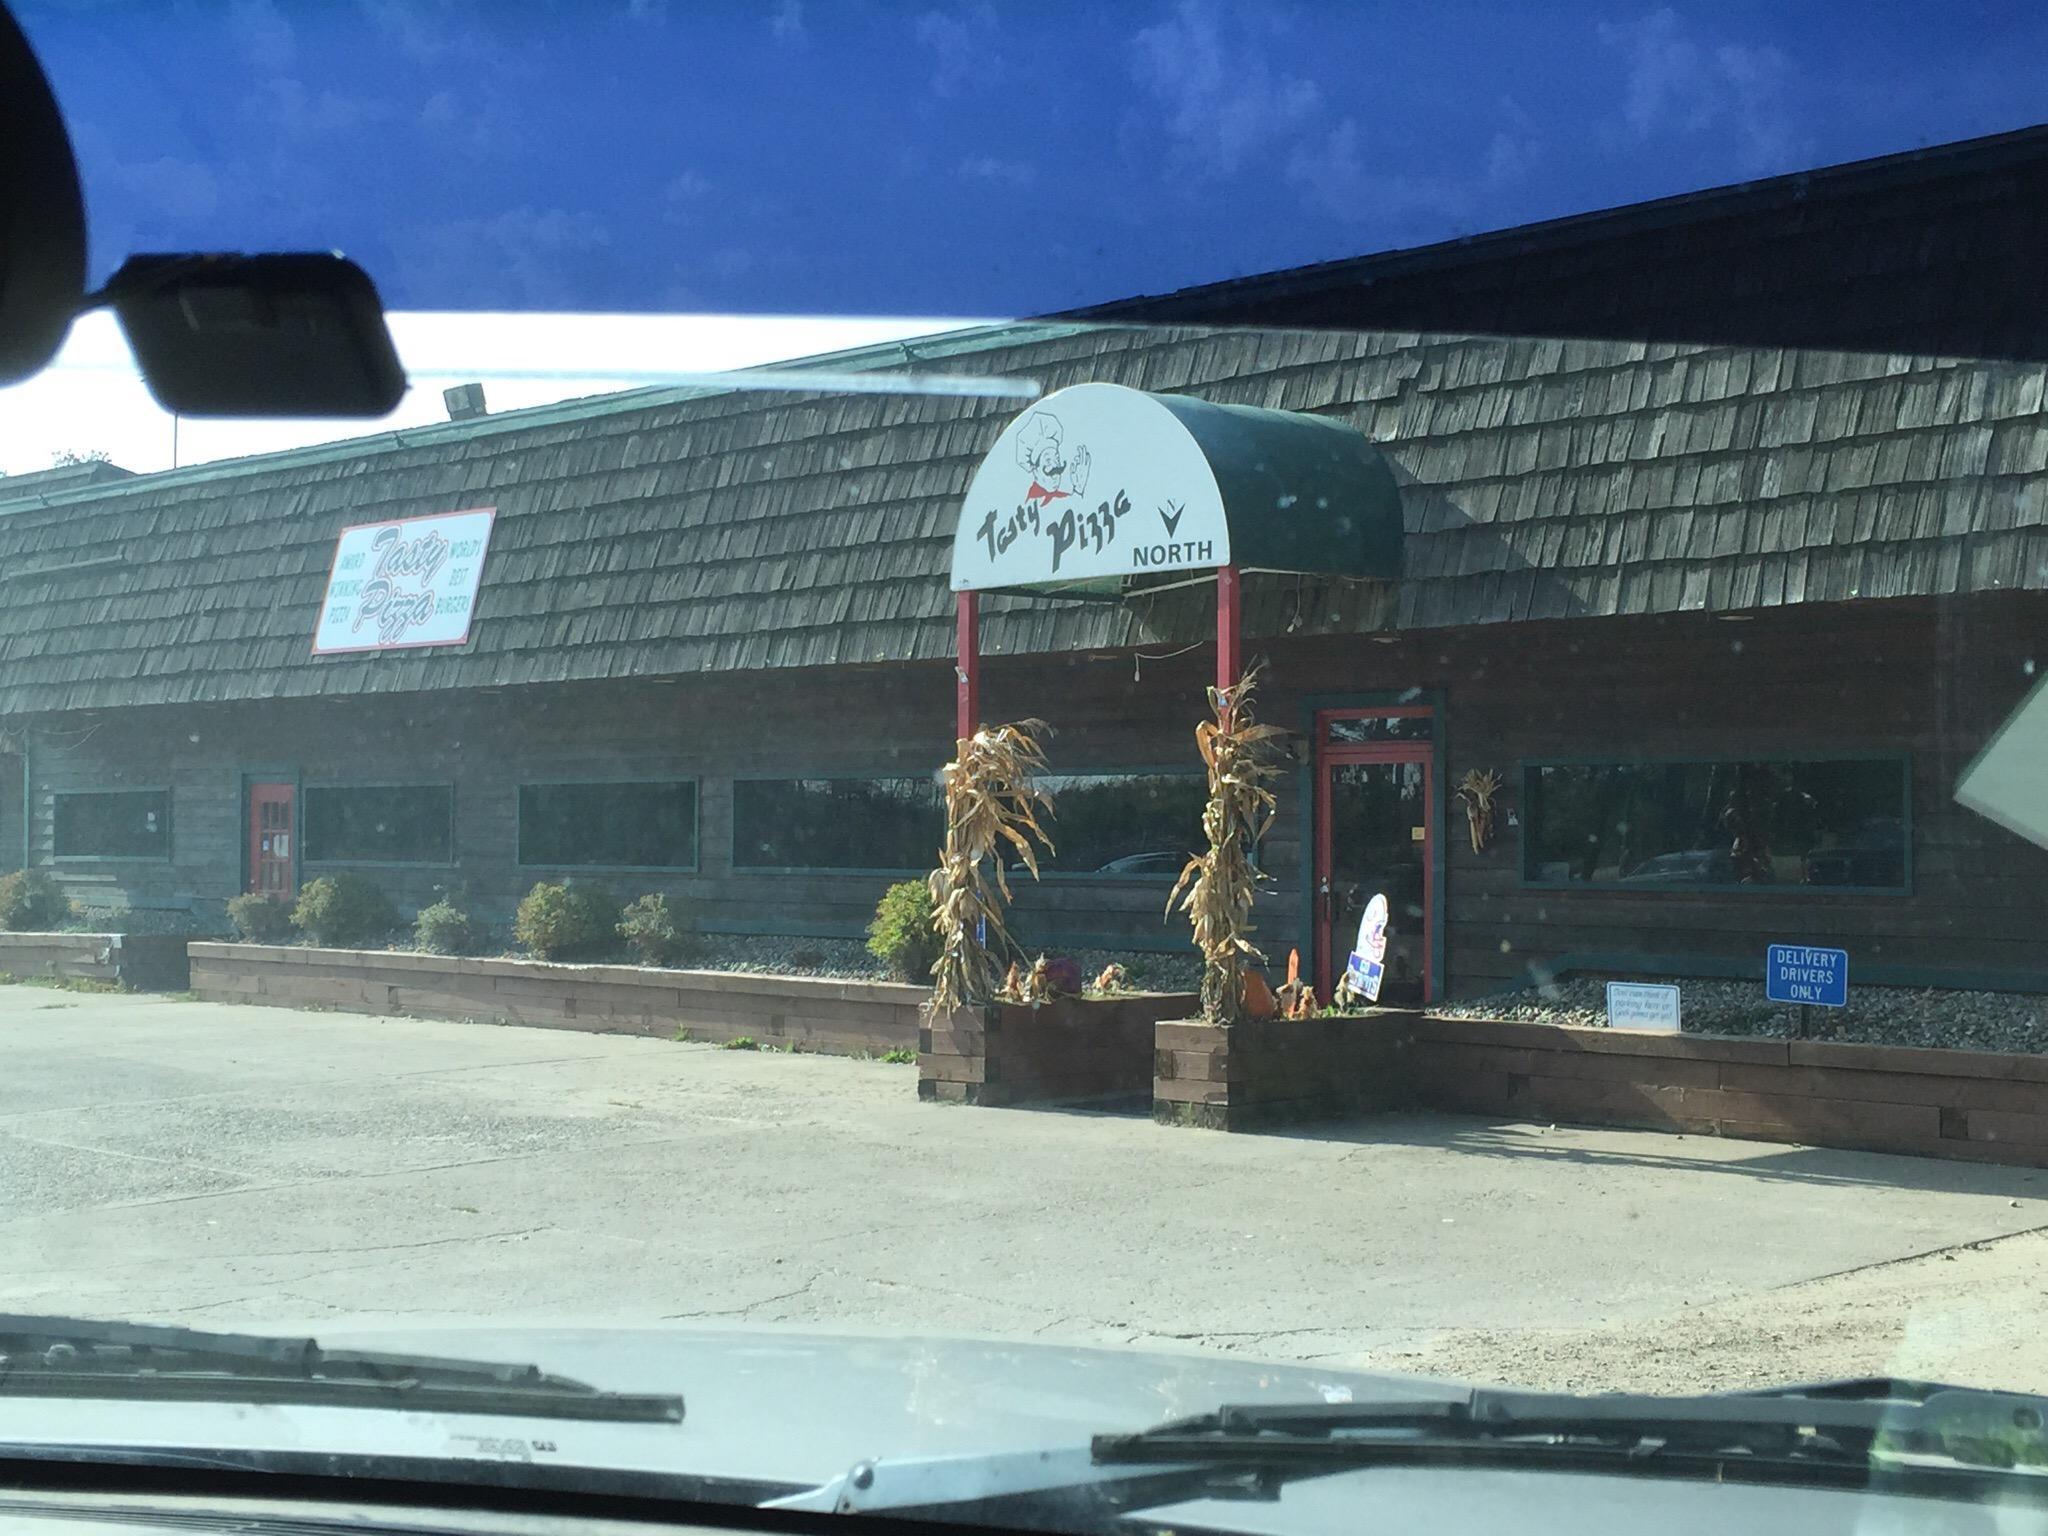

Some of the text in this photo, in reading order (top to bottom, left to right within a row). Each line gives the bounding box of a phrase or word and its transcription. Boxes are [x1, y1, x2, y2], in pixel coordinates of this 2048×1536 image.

[977, 489, 1131, 573] Tasty Pizza
[372, 525, 449, 587] Tasty
[1133, 540, 1213, 567] NORTH
[352, 578, 435, 644] Pizza
[1777, 950, 1837, 968] DELIVERY
[1781, 967, 1834, 984] DRIVERS
[1790, 984, 1822, 1000] ONLY
